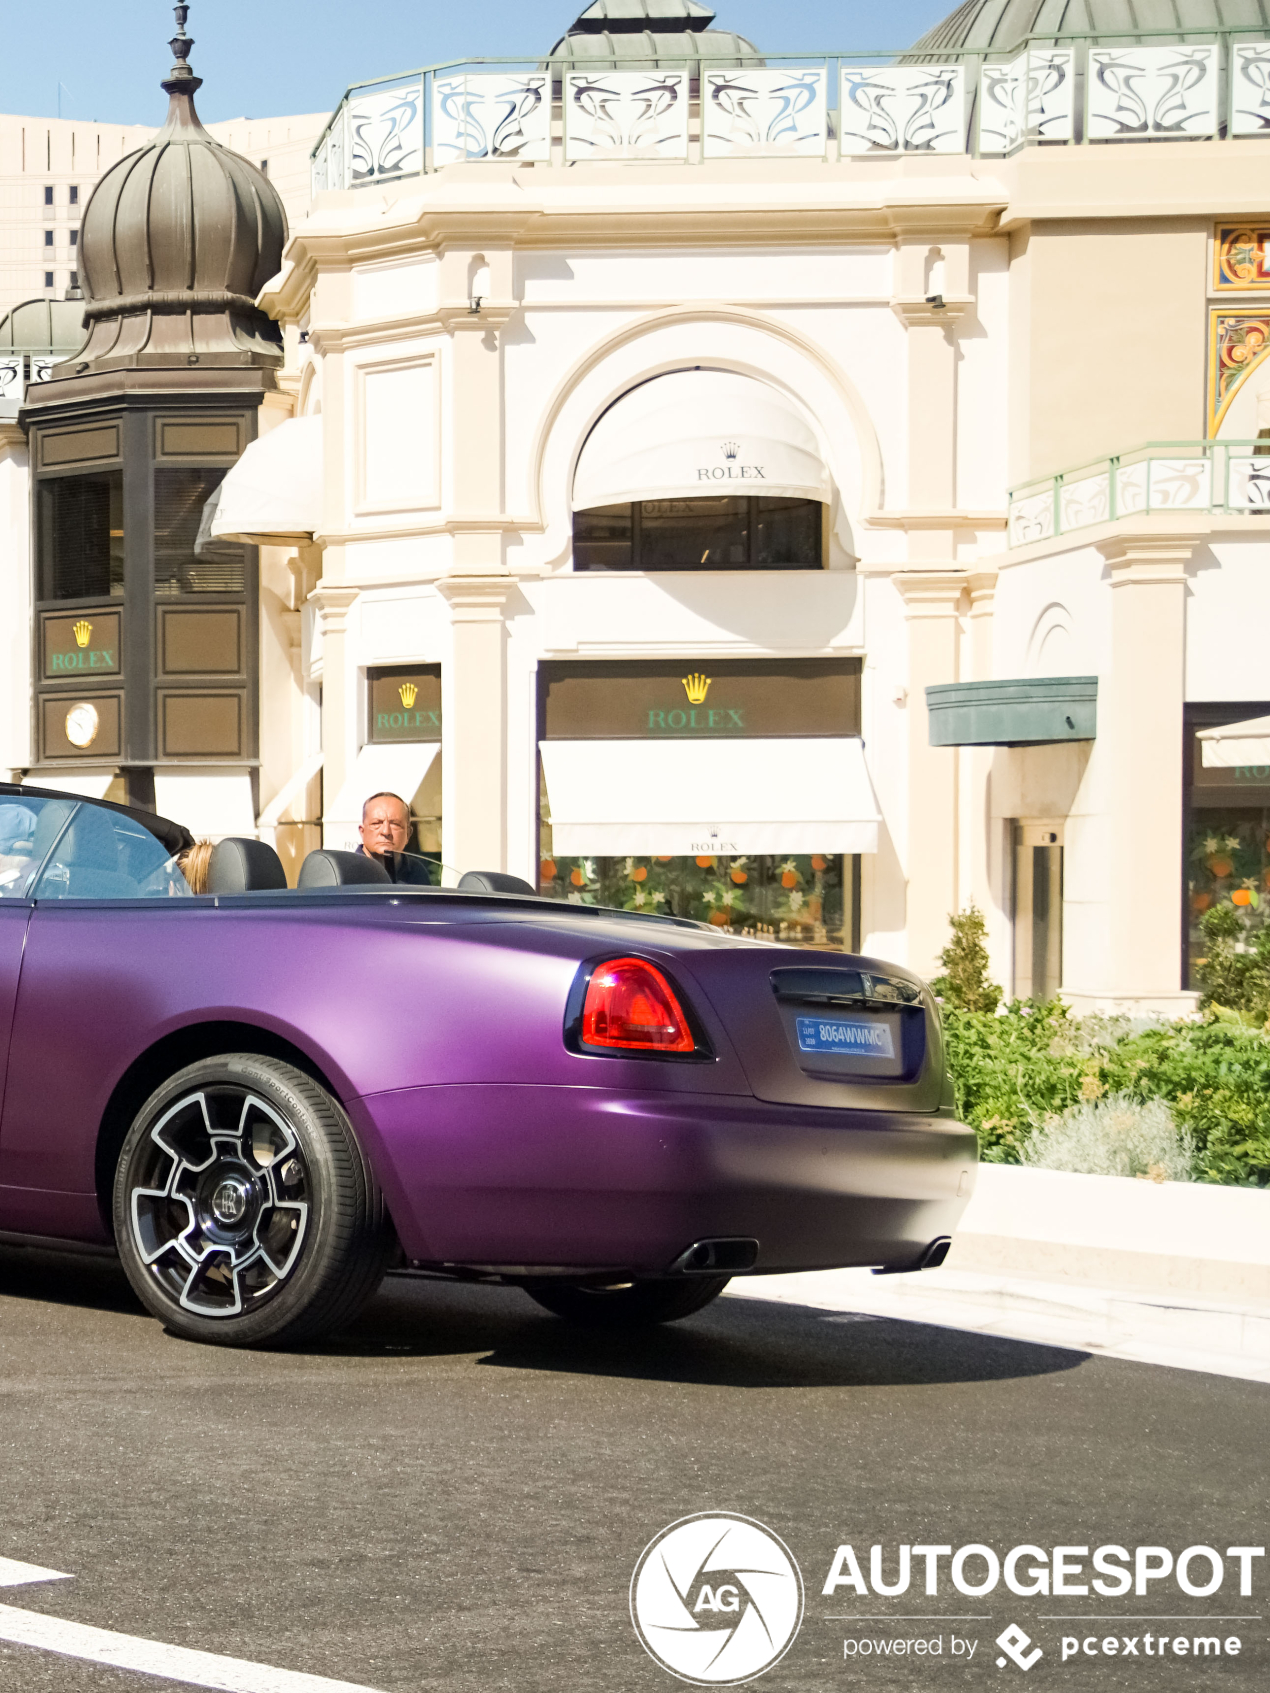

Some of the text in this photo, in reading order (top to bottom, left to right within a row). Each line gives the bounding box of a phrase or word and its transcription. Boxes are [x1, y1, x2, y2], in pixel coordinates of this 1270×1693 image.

[696, 466, 766, 481] ROLEX
[643, 502, 694, 514] OLEX
[52, 650, 114, 670] ROLEX
[377, 711, 441, 728] ROLEX
[647, 709, 745, 728] ROLEX
[1234, 766, 1270, 778] RO
[691, 842, 738, 852] ROLEX
[819, 1025, 882, 1045] 8064WWMC
